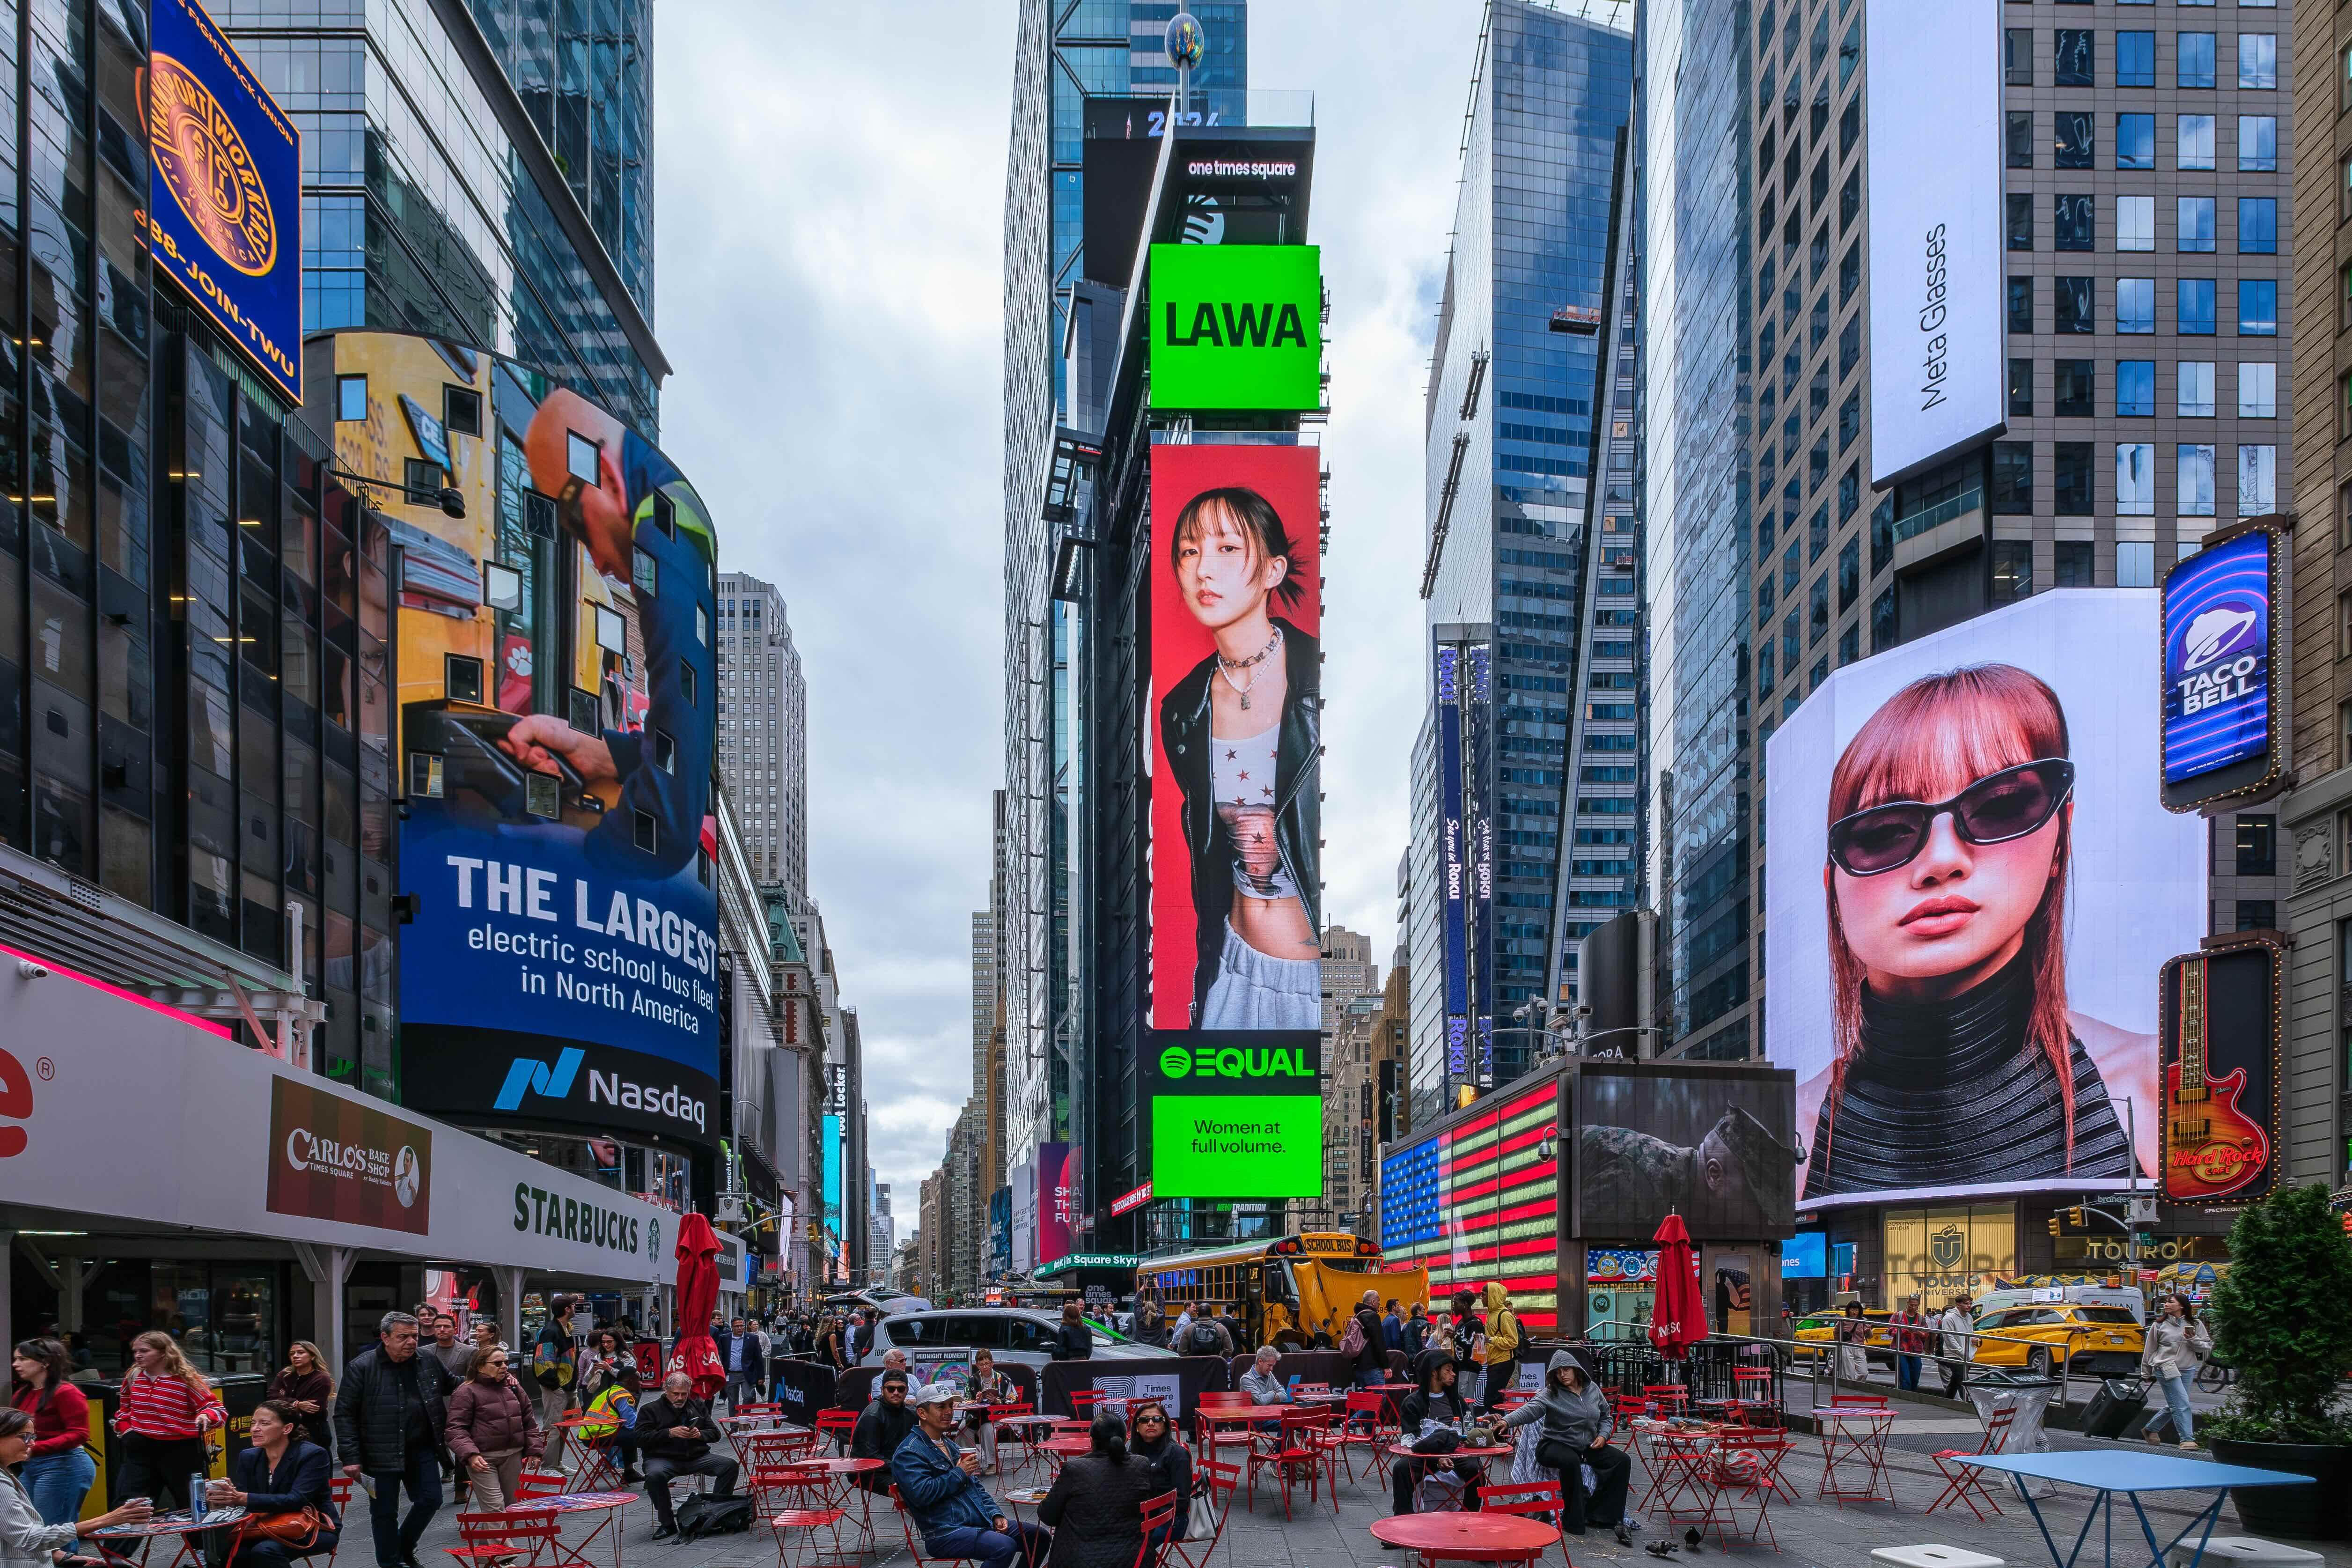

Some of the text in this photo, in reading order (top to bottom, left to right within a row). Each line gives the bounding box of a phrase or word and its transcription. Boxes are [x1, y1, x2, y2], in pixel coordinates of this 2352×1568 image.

[188, 7, 293, 146] FIGHTBACK UNION
[151, 70, 269, 255] TRANSPORT WORKERS
[1188, 161, 1296, 180] one times square
[1166, 302, 1308, 348] LAWA
[1919, 222, 1947, 412] Meta Glasses
[2177, 655, 2256, 698] TACO
[2183, 677, 2256, 717] BELL
[1447, 817, 1459, 836] See
[1445, 836, 1455, 852] you
[1448, 852, 1456, 862] in
[447, 855, 717, 982] THE LARGEST
[468, 923, 714, 1014] electric school bus fleet
[522, 965, 699, 1035] in North America
[1196, 1048, 1315, 1078] EQUAL
[834, 1067, 846, 1107] Locker
[589, 1069, 706, 1134] Nasdaq
[1194, 1119, 1281, 1134] Women at
[287, 1128, 367, 1171] CARLO'S
[1191, 1138, 1286, 1154] full volume.
[368, 1148, 390, 1165] BAKE
[2172, 1146, 2263, 1166] Hard Rock
[309, 1162, 354, 1179] TIMES SQUARE
[368, 1163, 390, 1178] SHOP
[2205, 1167, 2230, 1175] CAFE
[1054, 1199, 1079, 1210] THE
[514, 1181, 639, 1255] STARBUCKS
[991, 1221, 1002, 1237] MAKE
[1306, 1239, 1352, 1251] SCHOOL BUS
[2088, 1242, 2178, 1260] TOURO
[1073, 1255, 1111, 1267] Square
[1916, 1274, 1981, 1289] TOURO
[1085, 1296, 1118, 1305] square
[785, 1384, 804, 1408] Nasdaq
[1142, 1391, 1174, 1401] Square
[1145, 1384, 1172, 1393] Times
